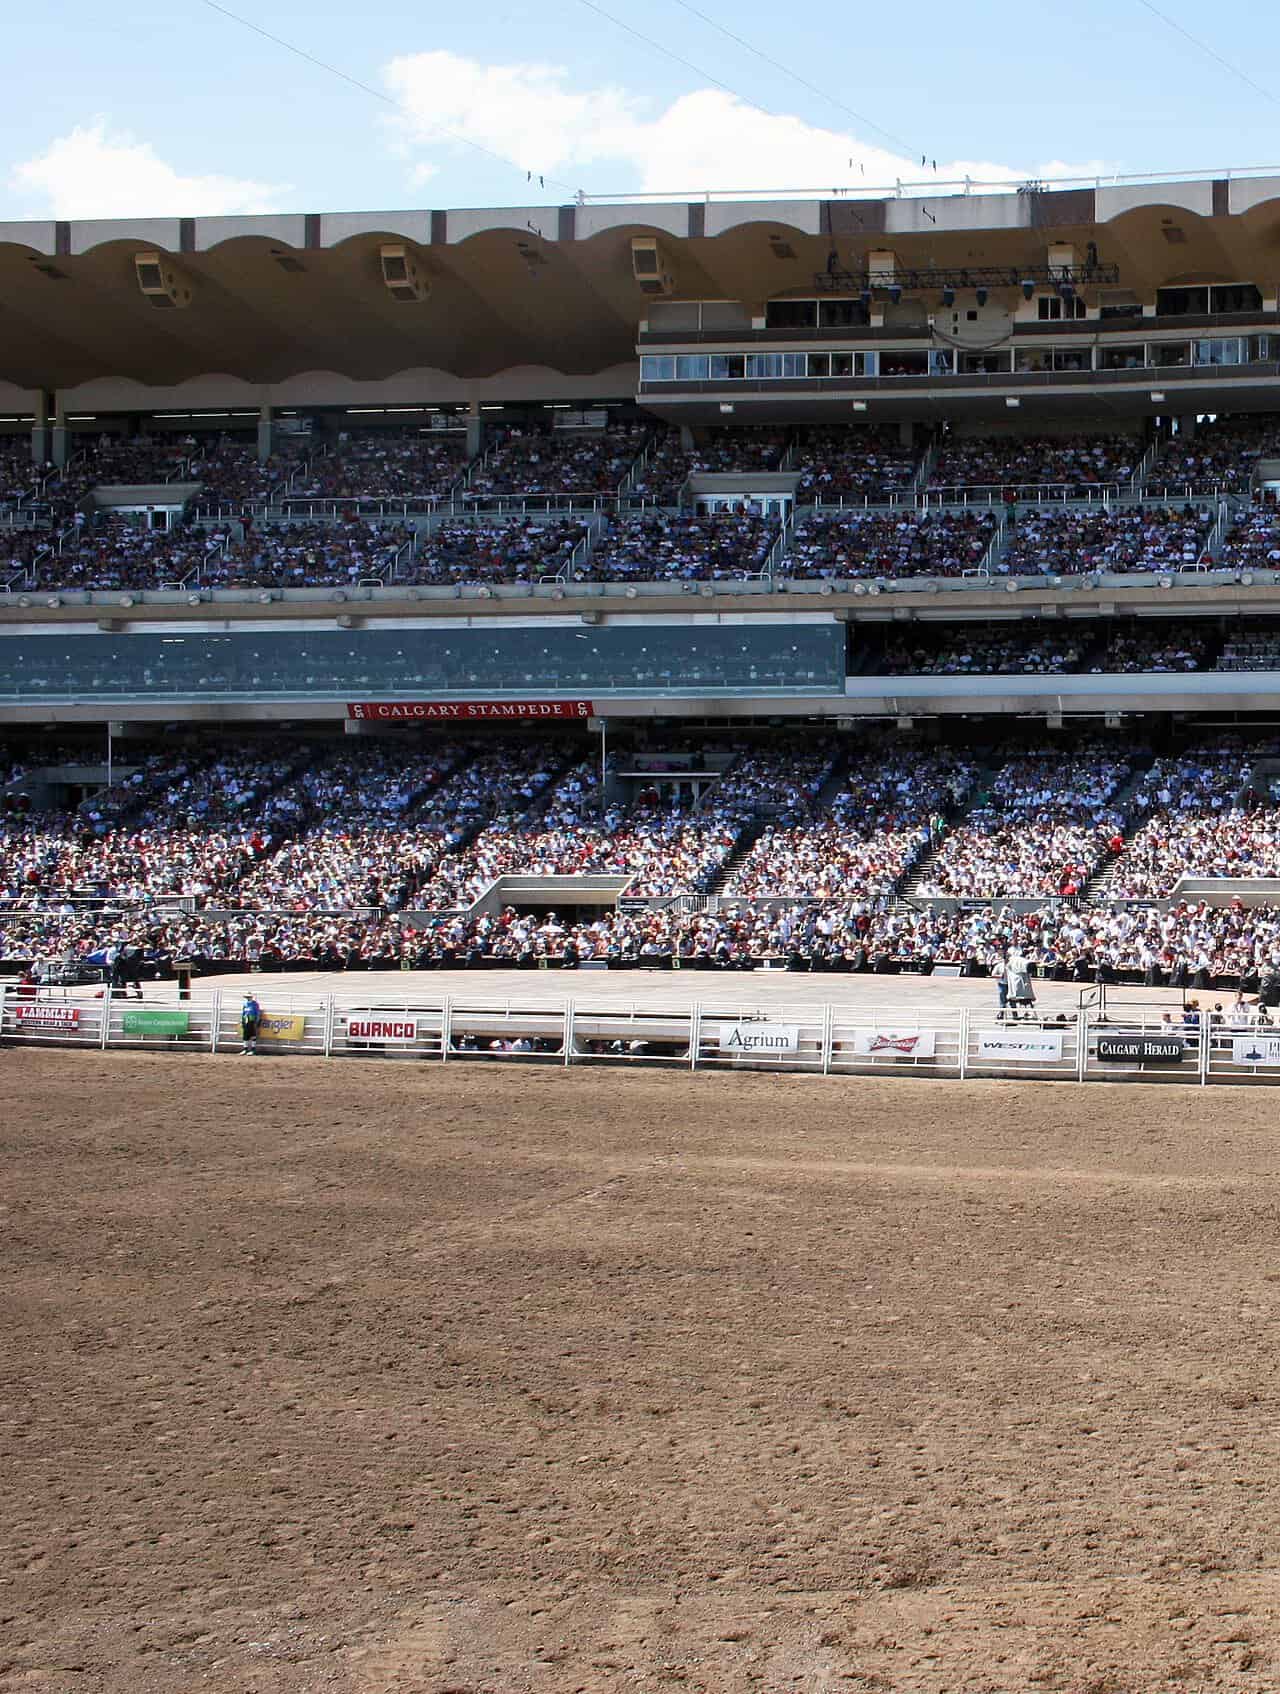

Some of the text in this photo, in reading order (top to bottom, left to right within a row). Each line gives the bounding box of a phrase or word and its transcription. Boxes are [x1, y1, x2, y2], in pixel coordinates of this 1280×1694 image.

[378, 703, 563, 717] CALGARY STAMPEDE
[350, 1022, 415, 1038] BURNCO
[728, 1028, 789, 1050] Agrium
[1100, 1042, 1180, 1056] CALGARY HERALD
